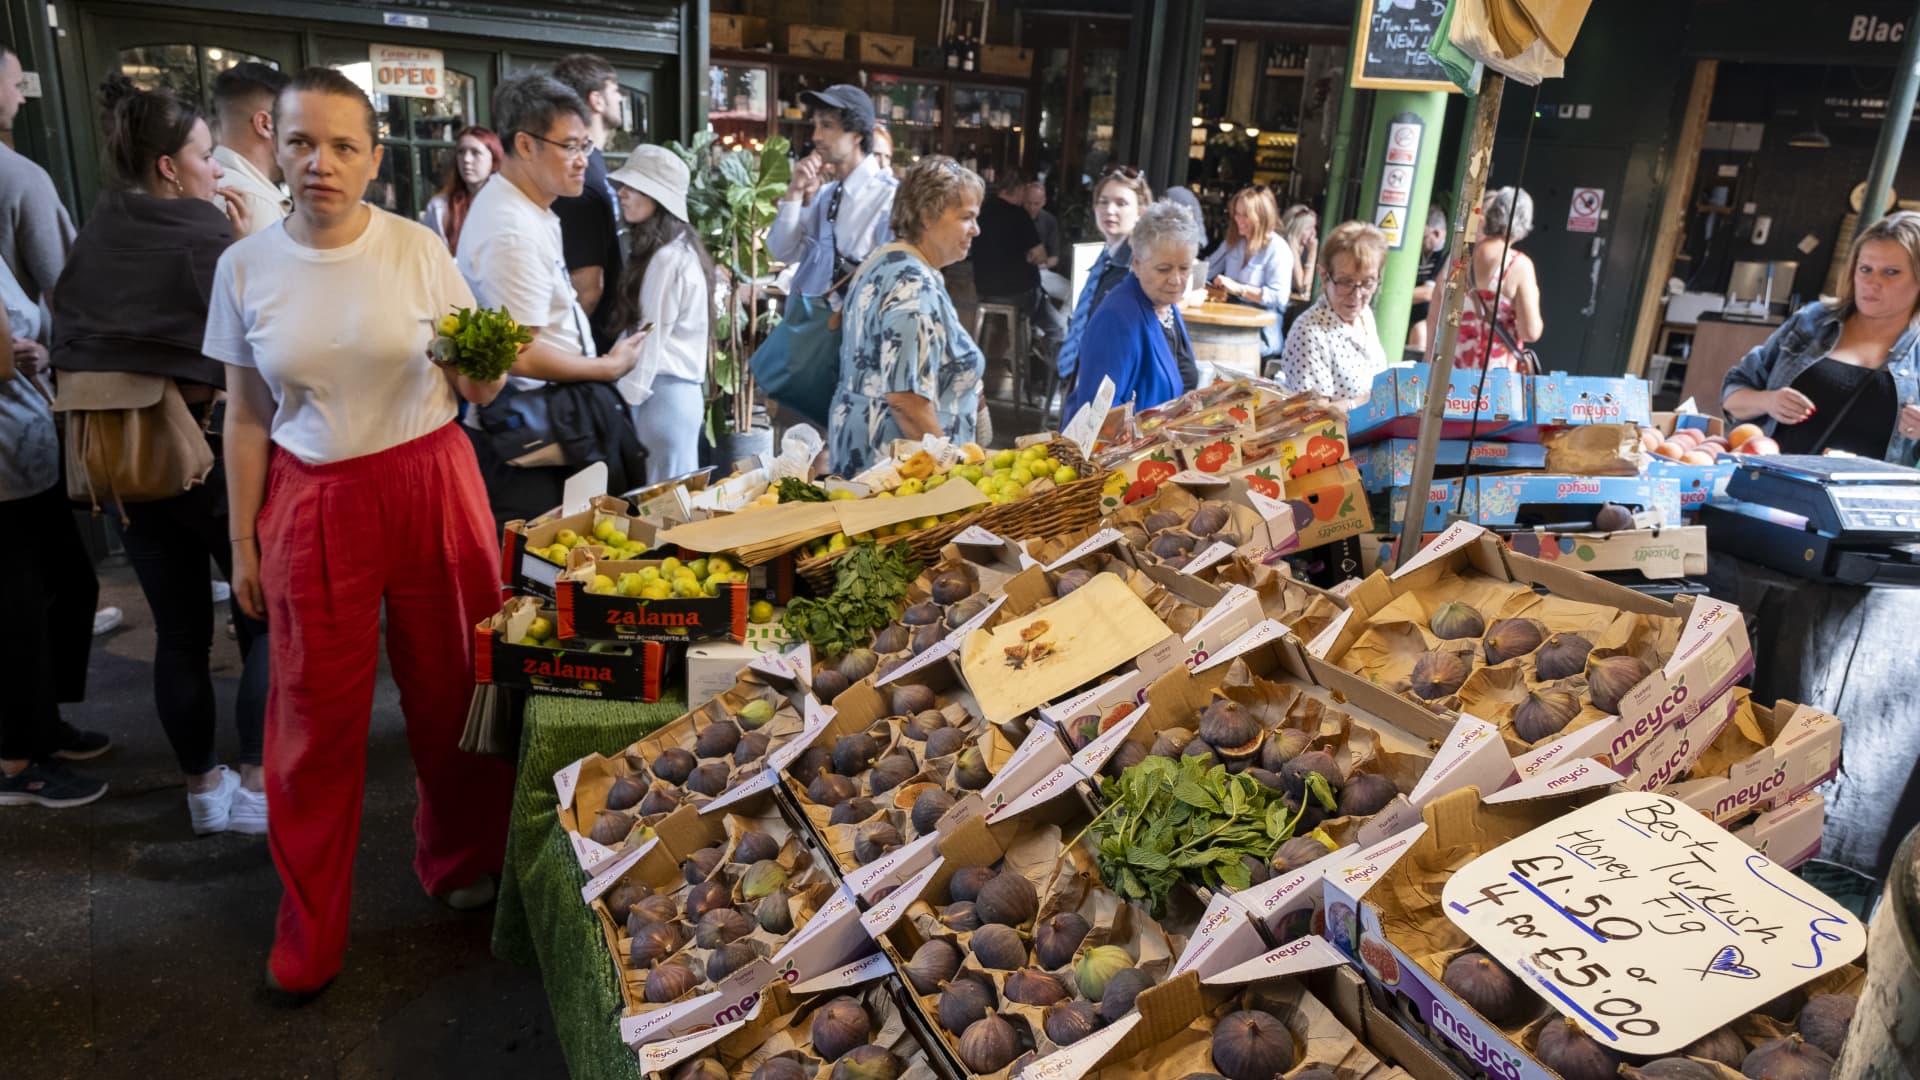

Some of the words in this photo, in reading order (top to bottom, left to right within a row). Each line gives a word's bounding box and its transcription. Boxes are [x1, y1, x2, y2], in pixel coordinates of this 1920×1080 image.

[1385, 34, 1418, 49] NEW
[1849, 16, 1904, 42] Blac
[378, 66, 436, 85] OPEN
[1572, 401, 1619, 418] meyco
[1558, 481, 1599, 496] meyco
[1680, 489, 1706, 506] yco
[1433, 526, 1462, 552] meyco
[607, 606, 700, 626] zalama
[1697, 605, 1722, 630] meyco
[523, 656, 612, 682] zalama
[1612, 687, 1687, 756] meyco
[1457, 724, 1486, 749] meyco
[1084, 745, 1109, 766] meyco
[1526, 744, 1563, 773] meyco
[1032, 770, 1064, 797] meyco
[1547, 767, 1589, 789] meyco
[1716, 771, 1785, 815] meyco
[1378, 813, 1398, 829] Turkey
[1625, 799, 1718, 852] Best
[862, 859, 895, 886] meyco
[1344, 865, 1378, 884] meyco
[1557, 829, 1638, 882] Honey
[1641, 891, 1706, 935] Fig
[1265, 875, 1306, 908] meyco
[1512, 856, 1642, 940] £1.50
[1650, 851, 1783, 944] Turkish
[869, 904, 896, 924] meyco
[1202, 906, 1229, 935] meyco
[1265, 939, 1311, 963] meyco
[1465, 883, 1519, 908] 4
[1497, 914, 1547, 938] for
[1535, 947, 1660, 1036] £5.00
[842, 955, 880, 977] meyco
[1626, 967, 1657, 984] or
[714, 969, 799, 1026] meo
[634, 1010, 672, 1036] meyco
[1433, 1001, 1521, 1080] meyco
[646, 1047, 678, 1060] meyco
[1034, 1058, 1073, 1080] meyco
